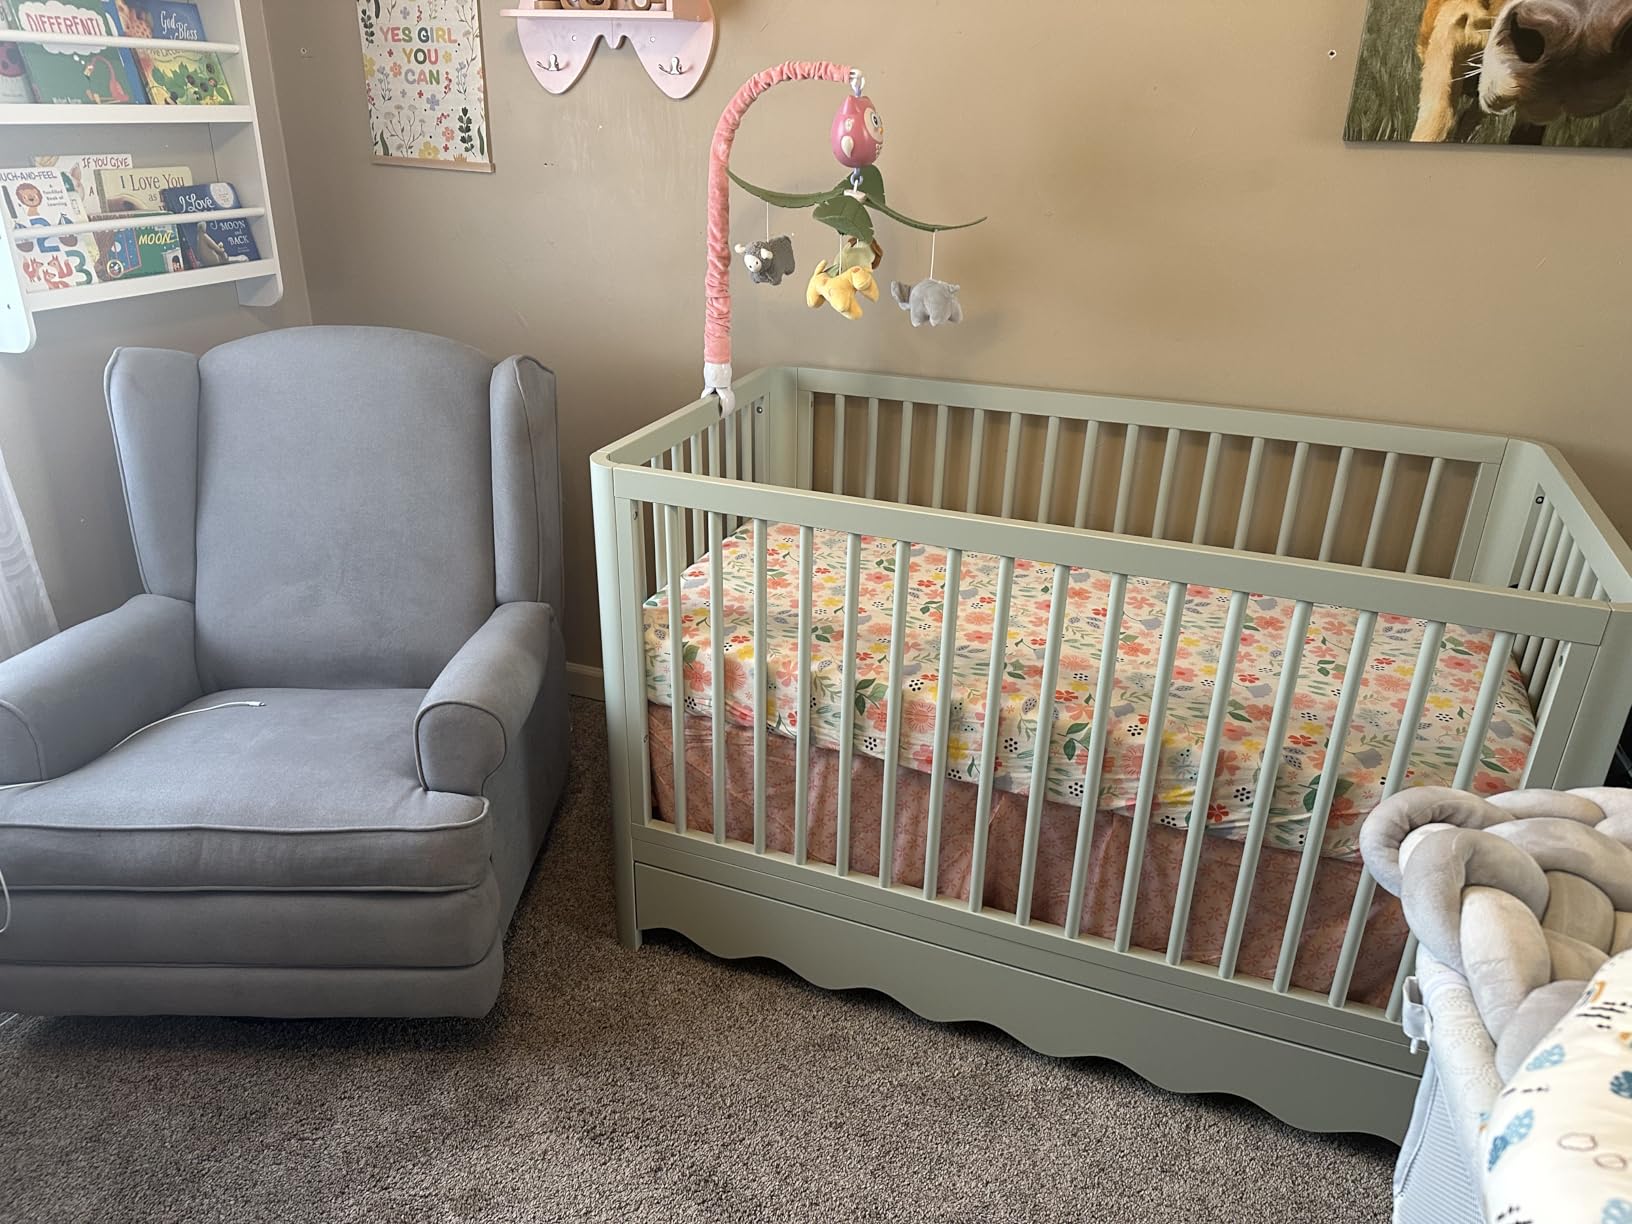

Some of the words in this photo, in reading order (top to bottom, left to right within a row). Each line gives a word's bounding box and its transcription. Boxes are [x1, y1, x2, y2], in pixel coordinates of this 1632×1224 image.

[160, 11, 176, 34] God
[176, 22, 198, 40] Bless
[380, 26, 413, 43] YES
[417, 26, 458, 44] GIRL
[402, 47, 439, 65] YOU
[404, 68, 440, 85] CAN
[82, 157, 91, 168] IF
[92, 156, 108, 168] YOU
[109, 157, 130, 169] GIVE
[0, 170, 58, 182] UCH-AND-FEEL
[120, 175, 126, 189] I
[129, 174, 161, 192] Love
[162, 173, 185, 188] You
[89, 186, 95, 197] A
[179, 195, 186, 212] I
[186, 193, 215, 213] Love
[221, 220, 246, 231] MOON
[138, 230, 177, 246] MOON
[227, 235, 250, 246] BACK
[64, 249, 93, 287] 3
